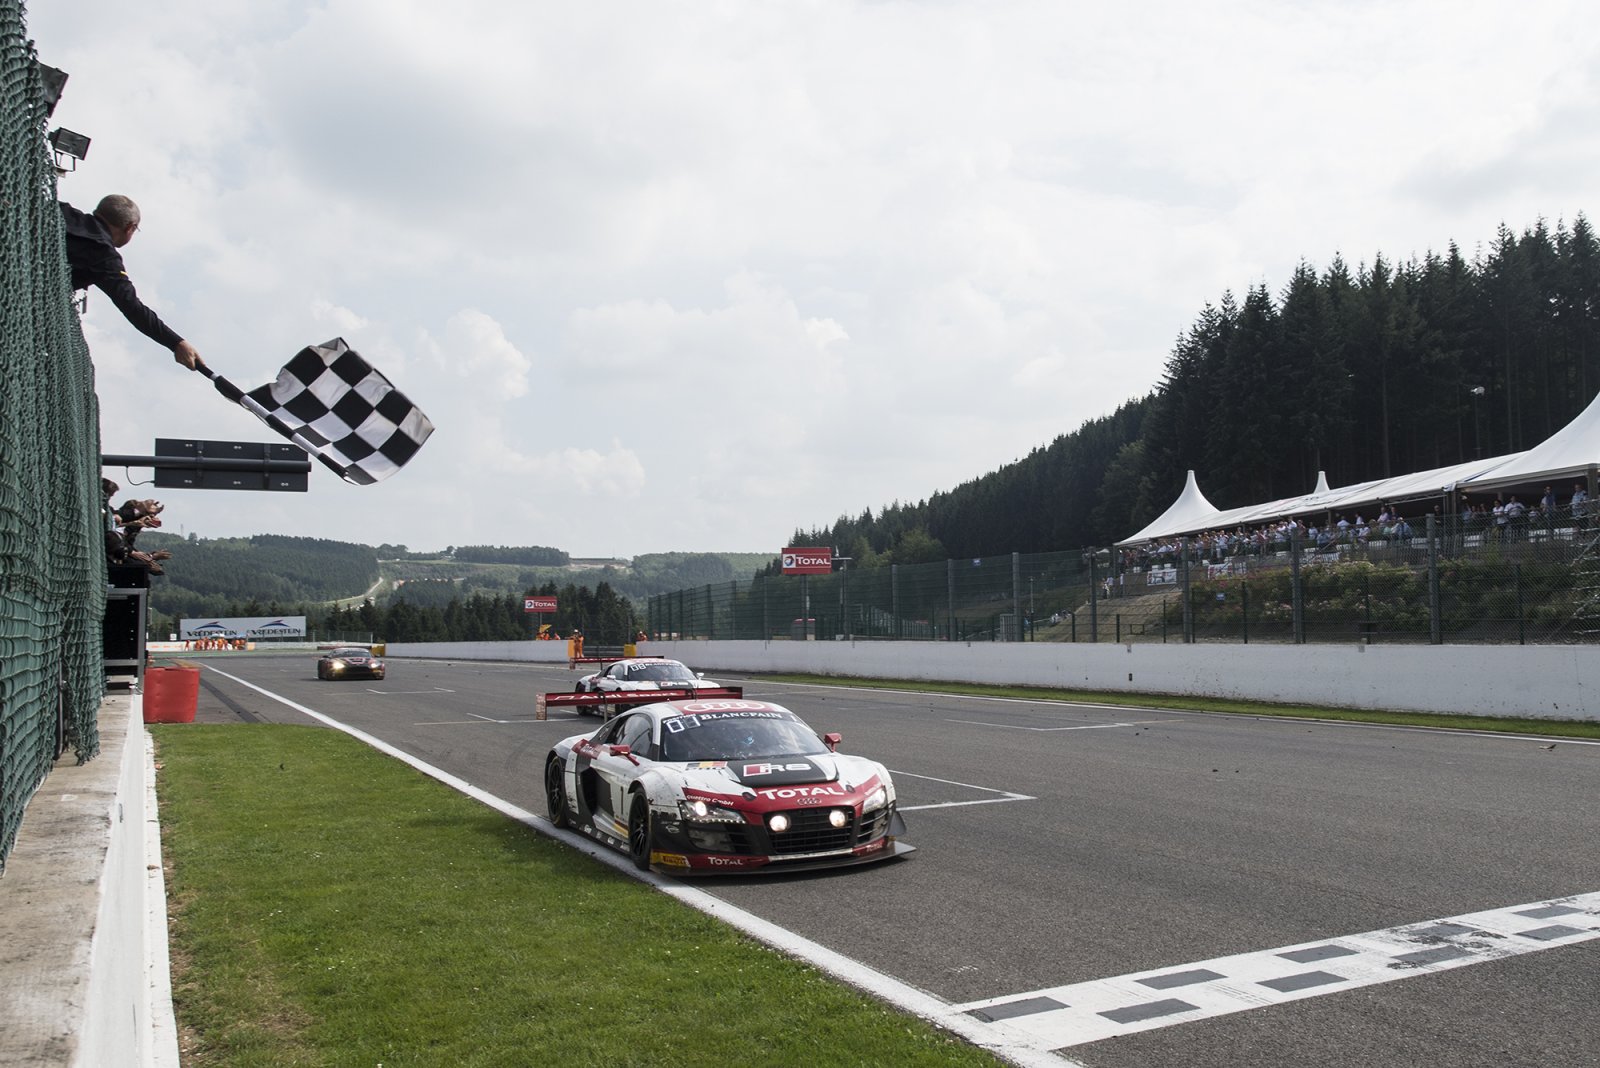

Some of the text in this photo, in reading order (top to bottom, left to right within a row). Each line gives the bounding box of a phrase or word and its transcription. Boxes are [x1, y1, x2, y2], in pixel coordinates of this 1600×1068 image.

[796, 556, 831, 566] TOTAL
[700, 712, 783, 721] BLANCPAIN
[757, 788, 845, 800] TOTAL
[707, 856, 743, 865] TOTAL
